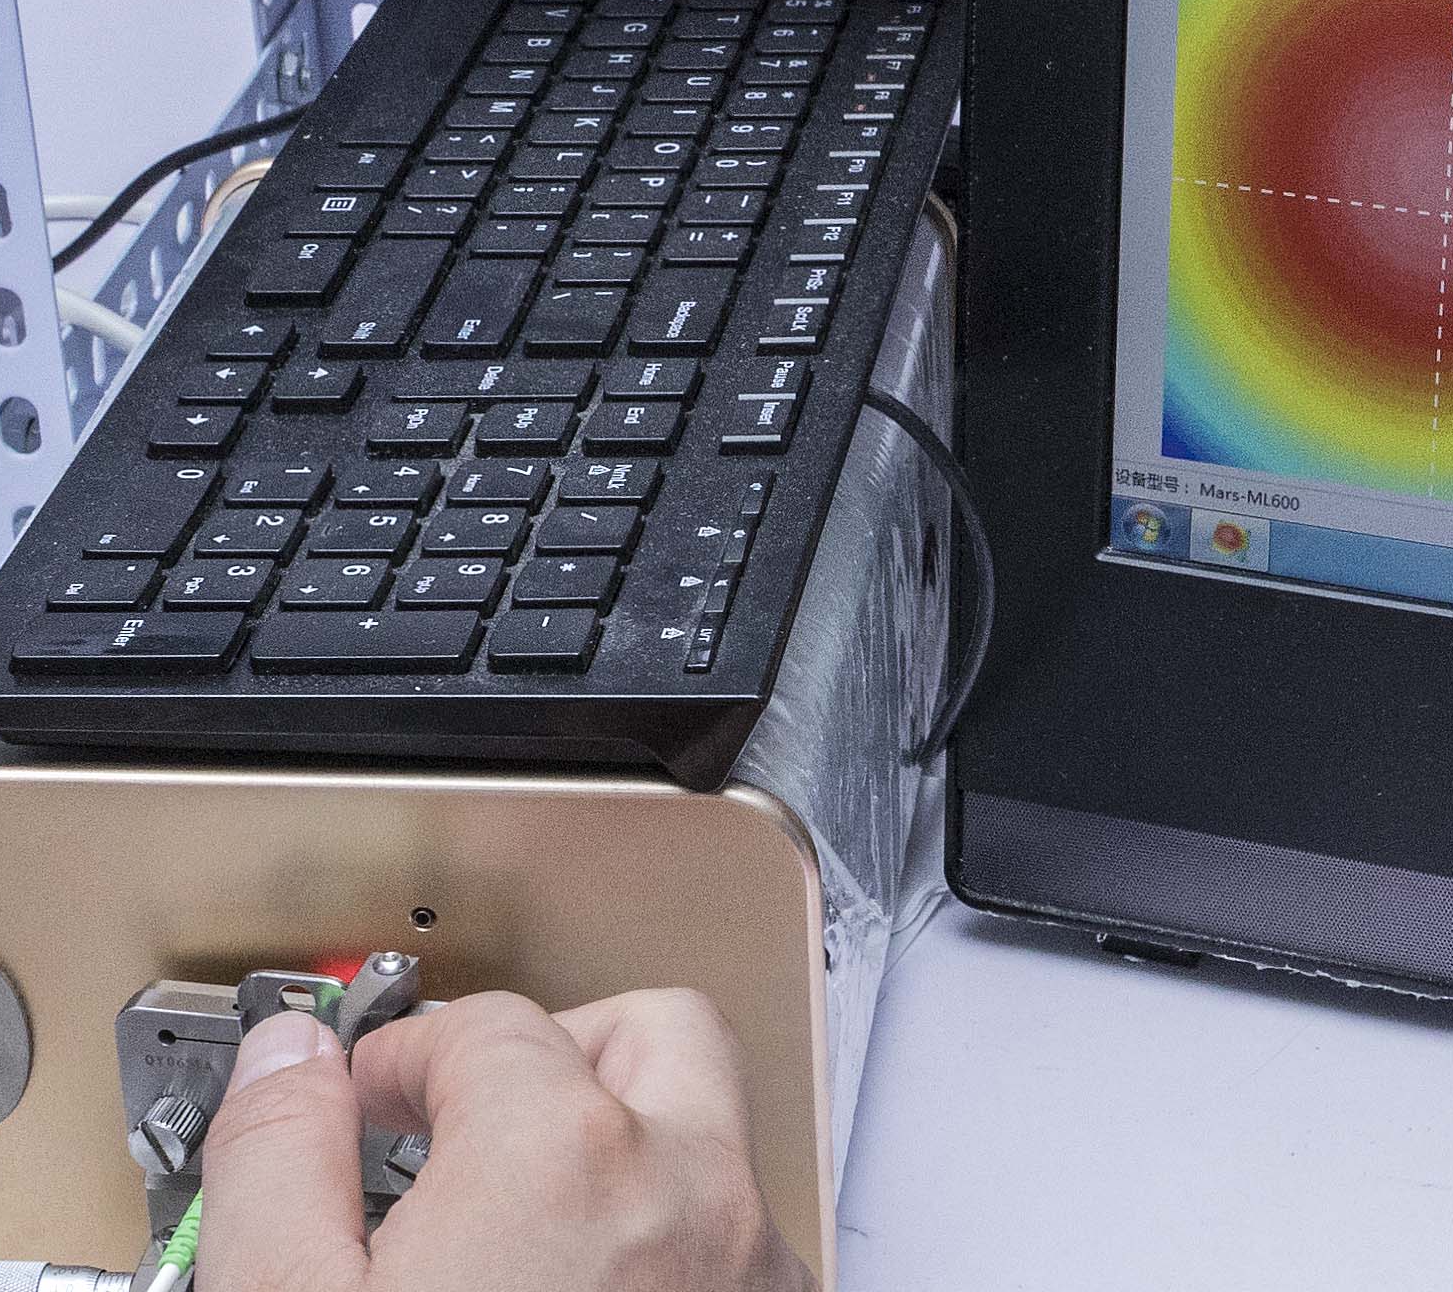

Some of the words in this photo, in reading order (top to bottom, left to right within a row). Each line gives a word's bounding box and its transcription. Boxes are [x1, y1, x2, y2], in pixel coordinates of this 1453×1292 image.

[479, 367, 503, 390] Delete
[625, 408, 644, 423] End
[1200, 483, 1300, 511] Mars-ML600
[481, 514, 509, 525] 8
[459, 565, 486, 574] 9
[113, 620, 144, 646] Enter
